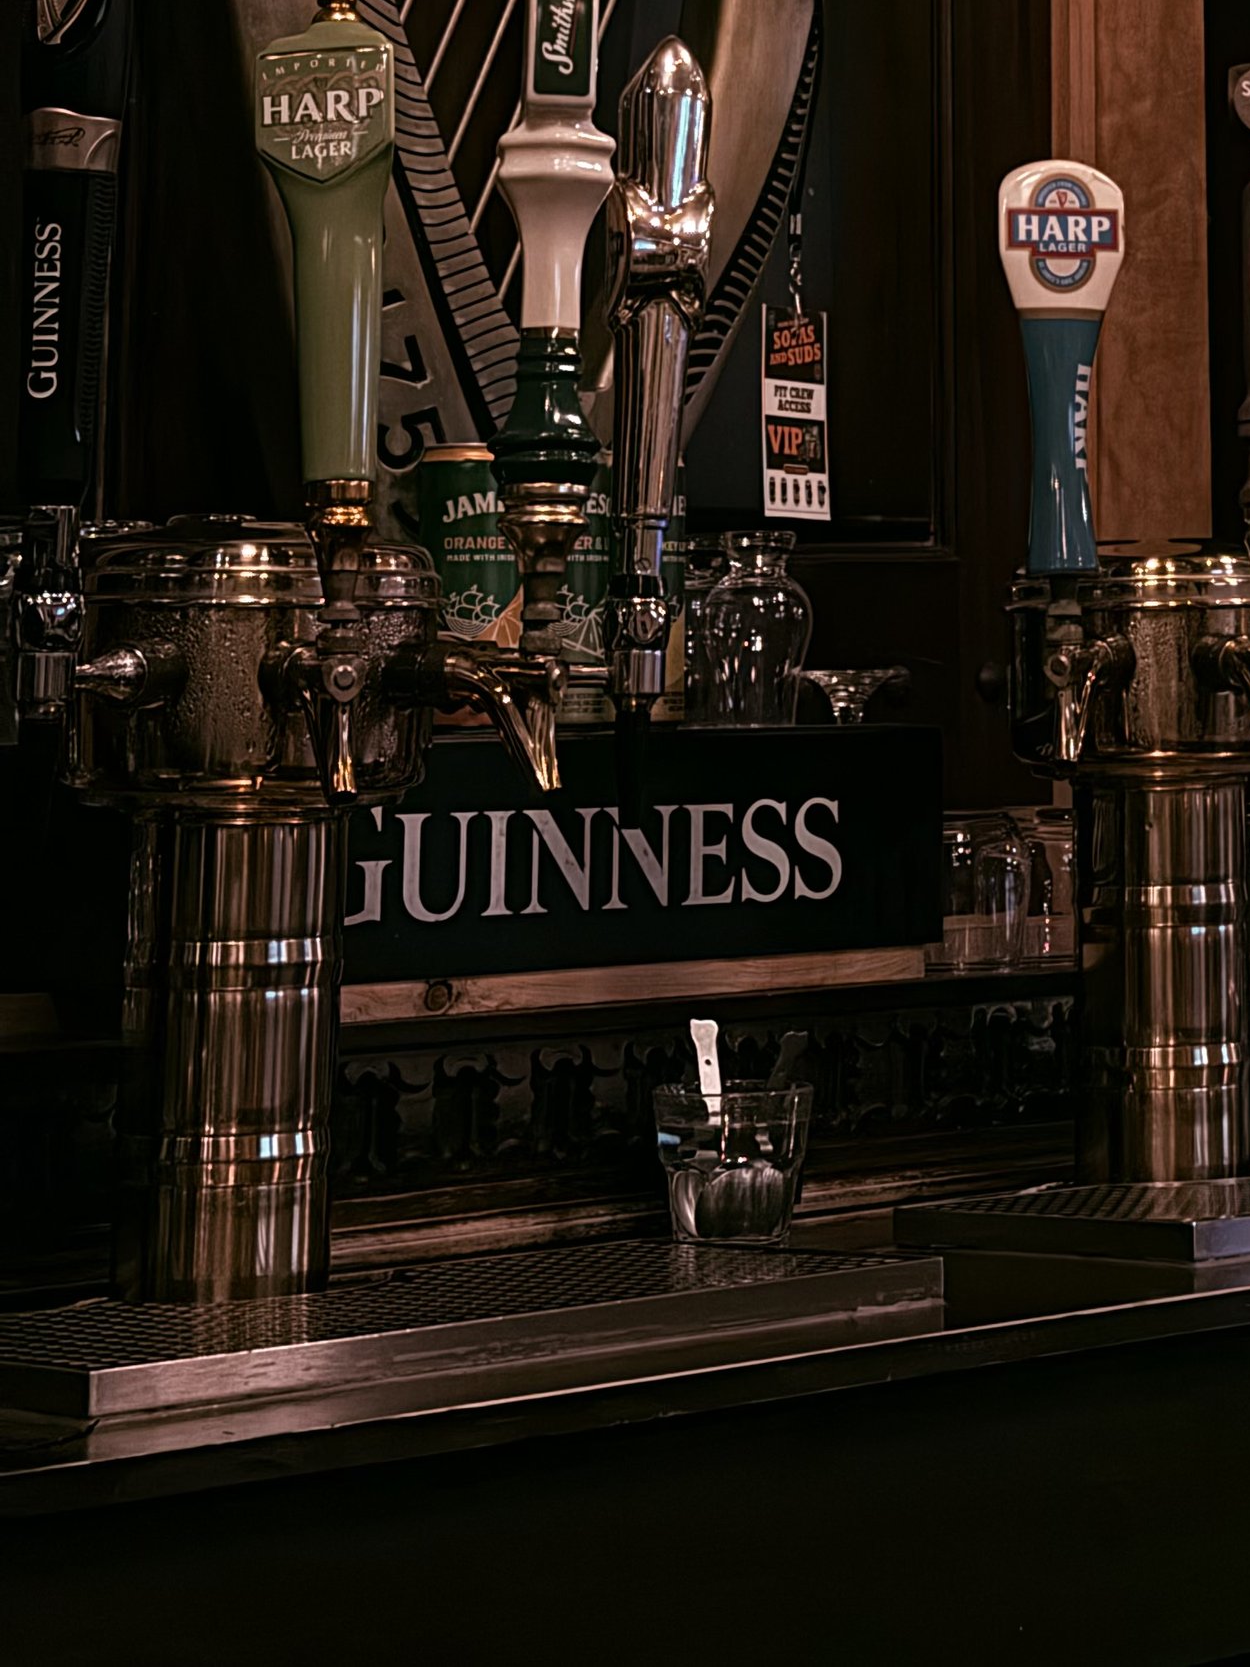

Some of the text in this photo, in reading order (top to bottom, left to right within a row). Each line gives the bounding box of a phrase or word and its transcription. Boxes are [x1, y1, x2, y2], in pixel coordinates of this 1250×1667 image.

[262, 58, 385, 81] IMPORTED
[262, 87, 382, 125] HARP
[291, 140, 352, 160] LAGER
[1017, 214, 1112, 243] HARP
[1039, 241, 1087, 253] LAGER
[27, 221, 62, 399] GUINNESS
[769, 343, 822, 367] AND SUDS
[773, 385, 815, 401] PIT CREW
[777, 399, 812, 414] ACCESS
[767, 423, 804, 456] VIP
[442, 490, 505, 524] JAM
[444, 536, 506, 550] ORANGE
[473, 554, 495, 562] WITH
